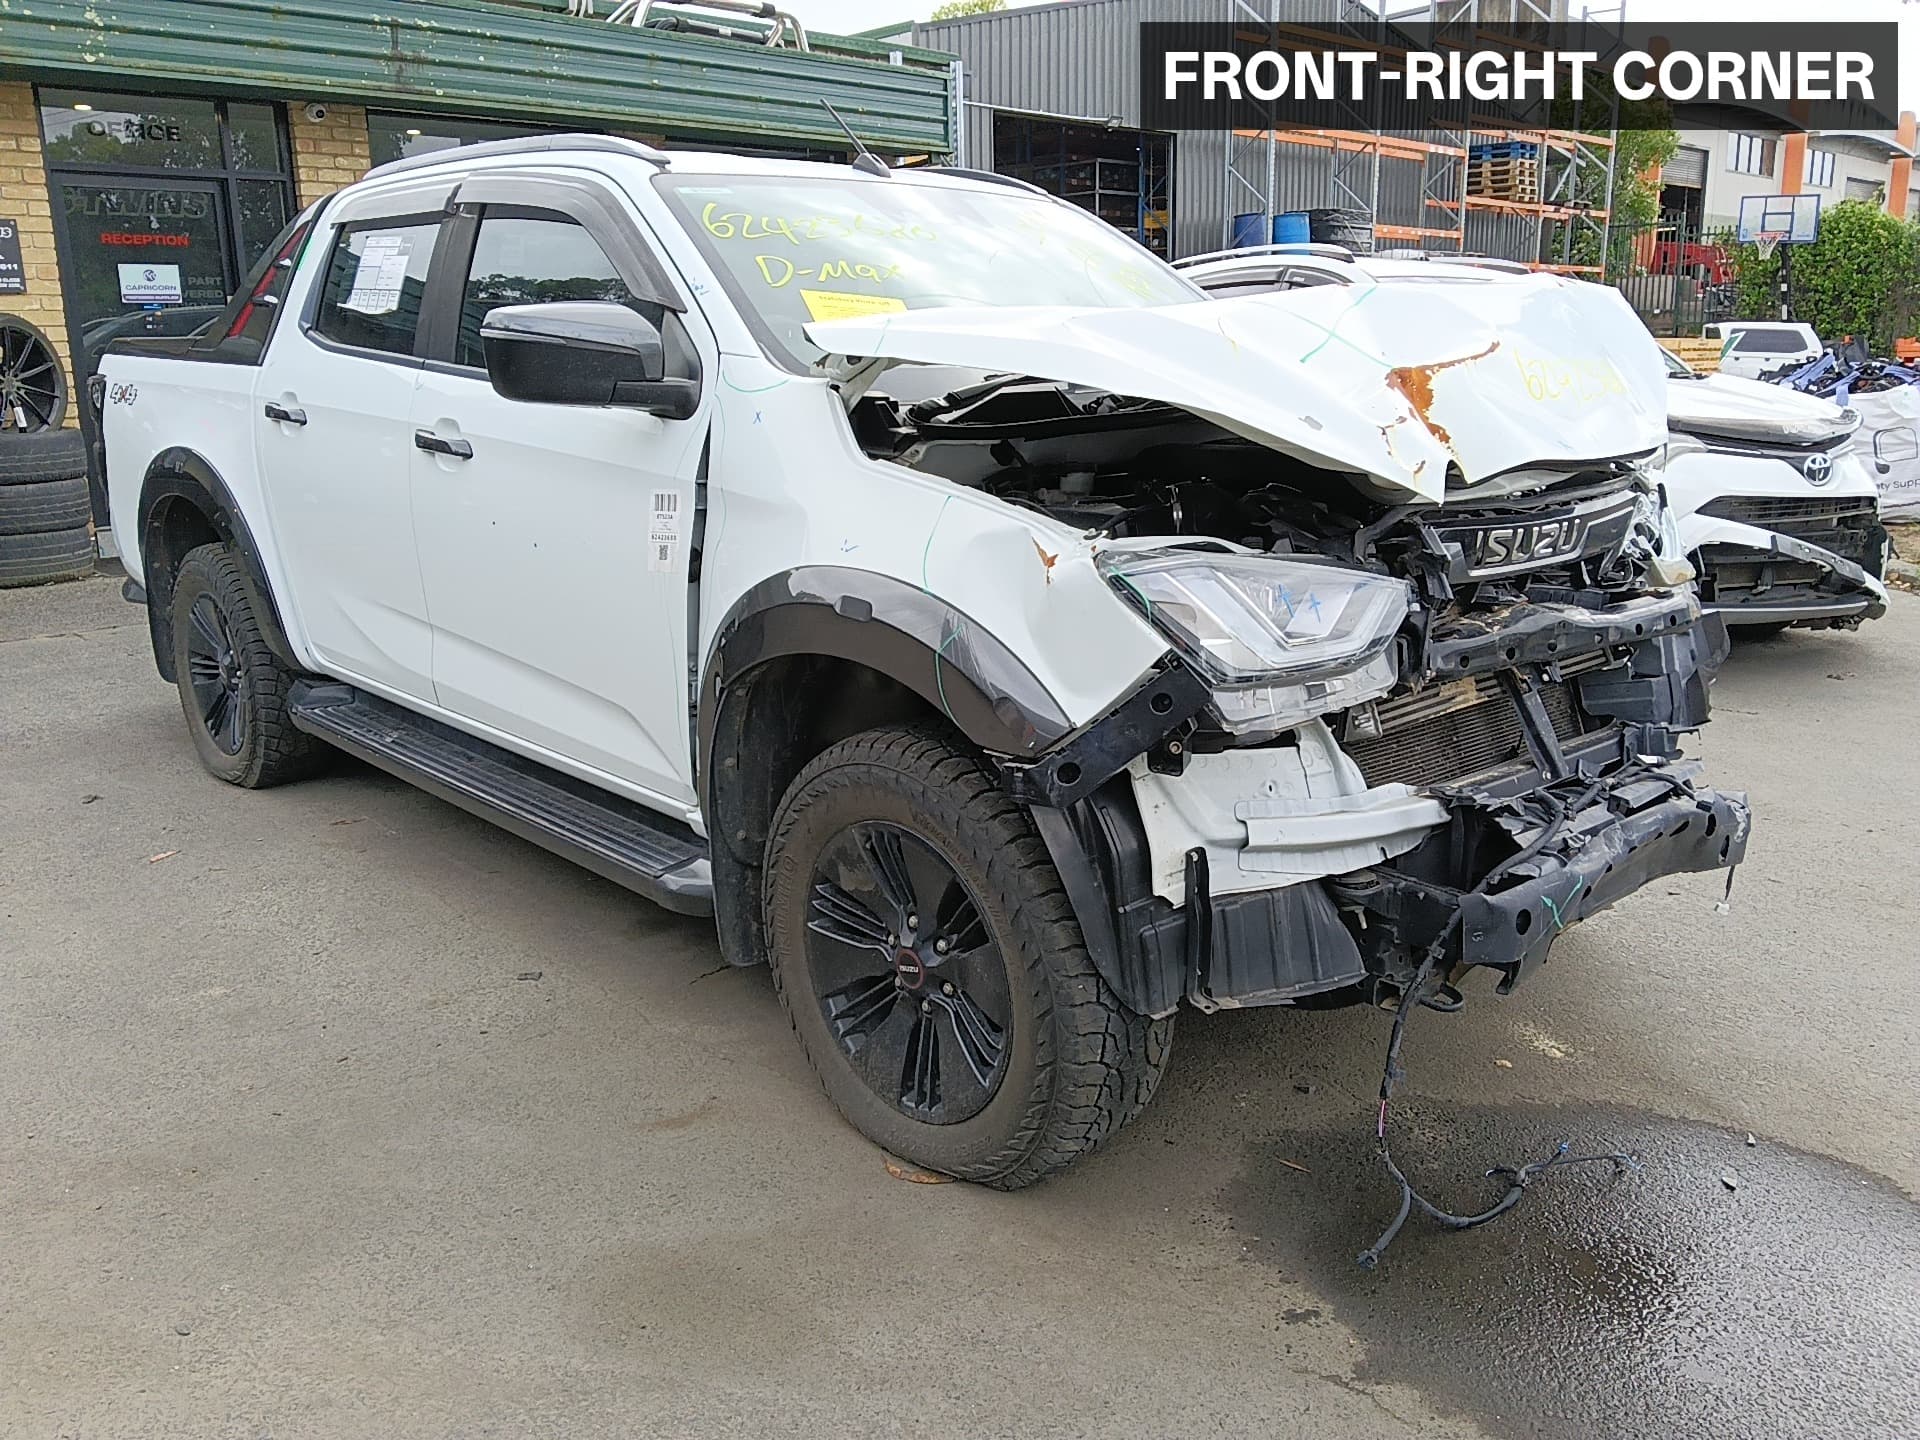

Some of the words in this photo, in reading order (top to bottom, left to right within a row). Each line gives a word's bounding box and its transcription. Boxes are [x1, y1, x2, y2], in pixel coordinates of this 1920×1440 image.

[87, 119, 182, 143] OFFICE
[101, 232, 190, 247] RECEPTION
[125, 283, 177, 291] CAPRICORN
[187, 276, 223, 286] PART
[1474, 518, 1582, 567] ISUZU
[899, 964, 919, 973] ISUZU
